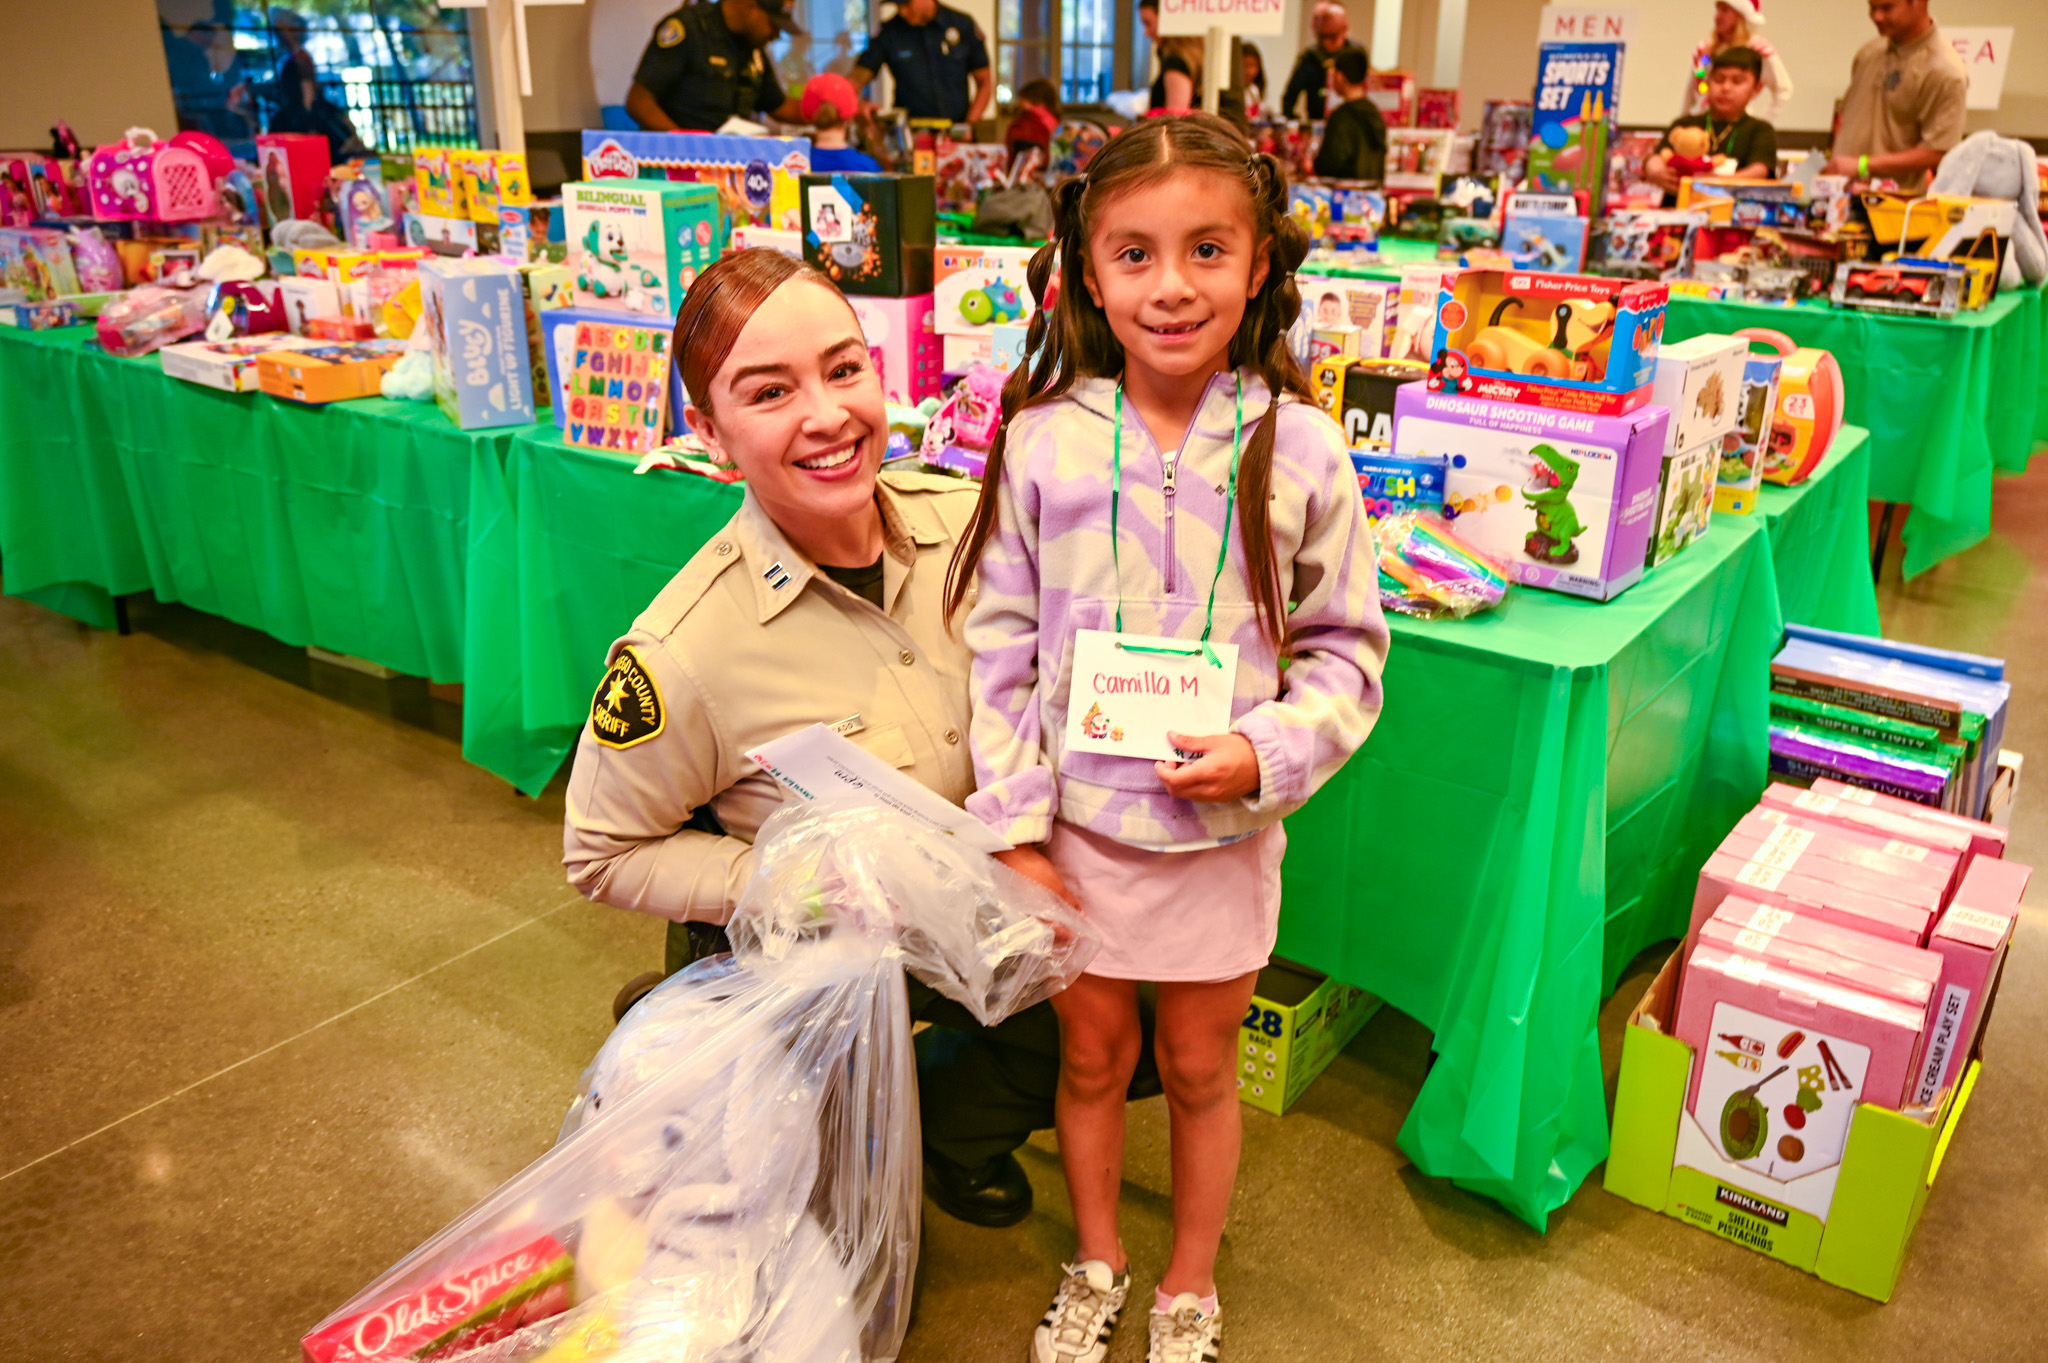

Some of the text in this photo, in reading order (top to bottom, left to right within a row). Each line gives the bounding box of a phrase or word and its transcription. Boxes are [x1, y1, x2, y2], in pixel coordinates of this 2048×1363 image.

[1164, 0, 1280, 13] CHILDREN
[1555, 16, 1623, 37] MEN
[1542, 61, 1611, 86] SPORTS
[1538, 86, 1574, 111] SET
[576, 191, 647, 206] BILINGUAL
[944, 257, 1004, 269] BABY TOYS
[1535, 279, 1611, 295] Fisher-Price Toys
[497, 288, 516, 351] FIGURINE
[503, 352, 518, 370] UP
[506, 372, 523, 410] LIGHT
[1477, 383, 1521, 398] MICKEY
[1425, 396, 1489, 419] DINOSAUR
[1490, 405, 1555, 428] SHOOTING
[1557, 417, 1596, 434] GAME
[1469, 417, 1543, 435] FULL OF HAPPINESS
[1357, 473, 1416, 498] PUSH
[628, 667, 656, 726] COUNTY
[1180, 675, 1198, 697] M
[594, 703, 631, 737] SHERIFF
[1816, 717, 1926, 749] SUPER ACTIVITY
[1787, 759, 1925, 802] SUPER ACTIVITY
[1242, 1004, 1282, 1037] 28
[1248, 1033, 1272, 1049] BAGS
[1925, 1045, 1946, 1086] CREAM
[1937, 1018, 1954, 1046] PLAY
[1946, 993, 1962, 1016] SET
[1720, 1187, 1786, 1221] KIRKLAND
[1717, 1221, 1774, 1252] PISTACHIOS
[1728, 1211, 1769, 1237] SHELLED
[354, 1252, 535, 1357] Old Spice
